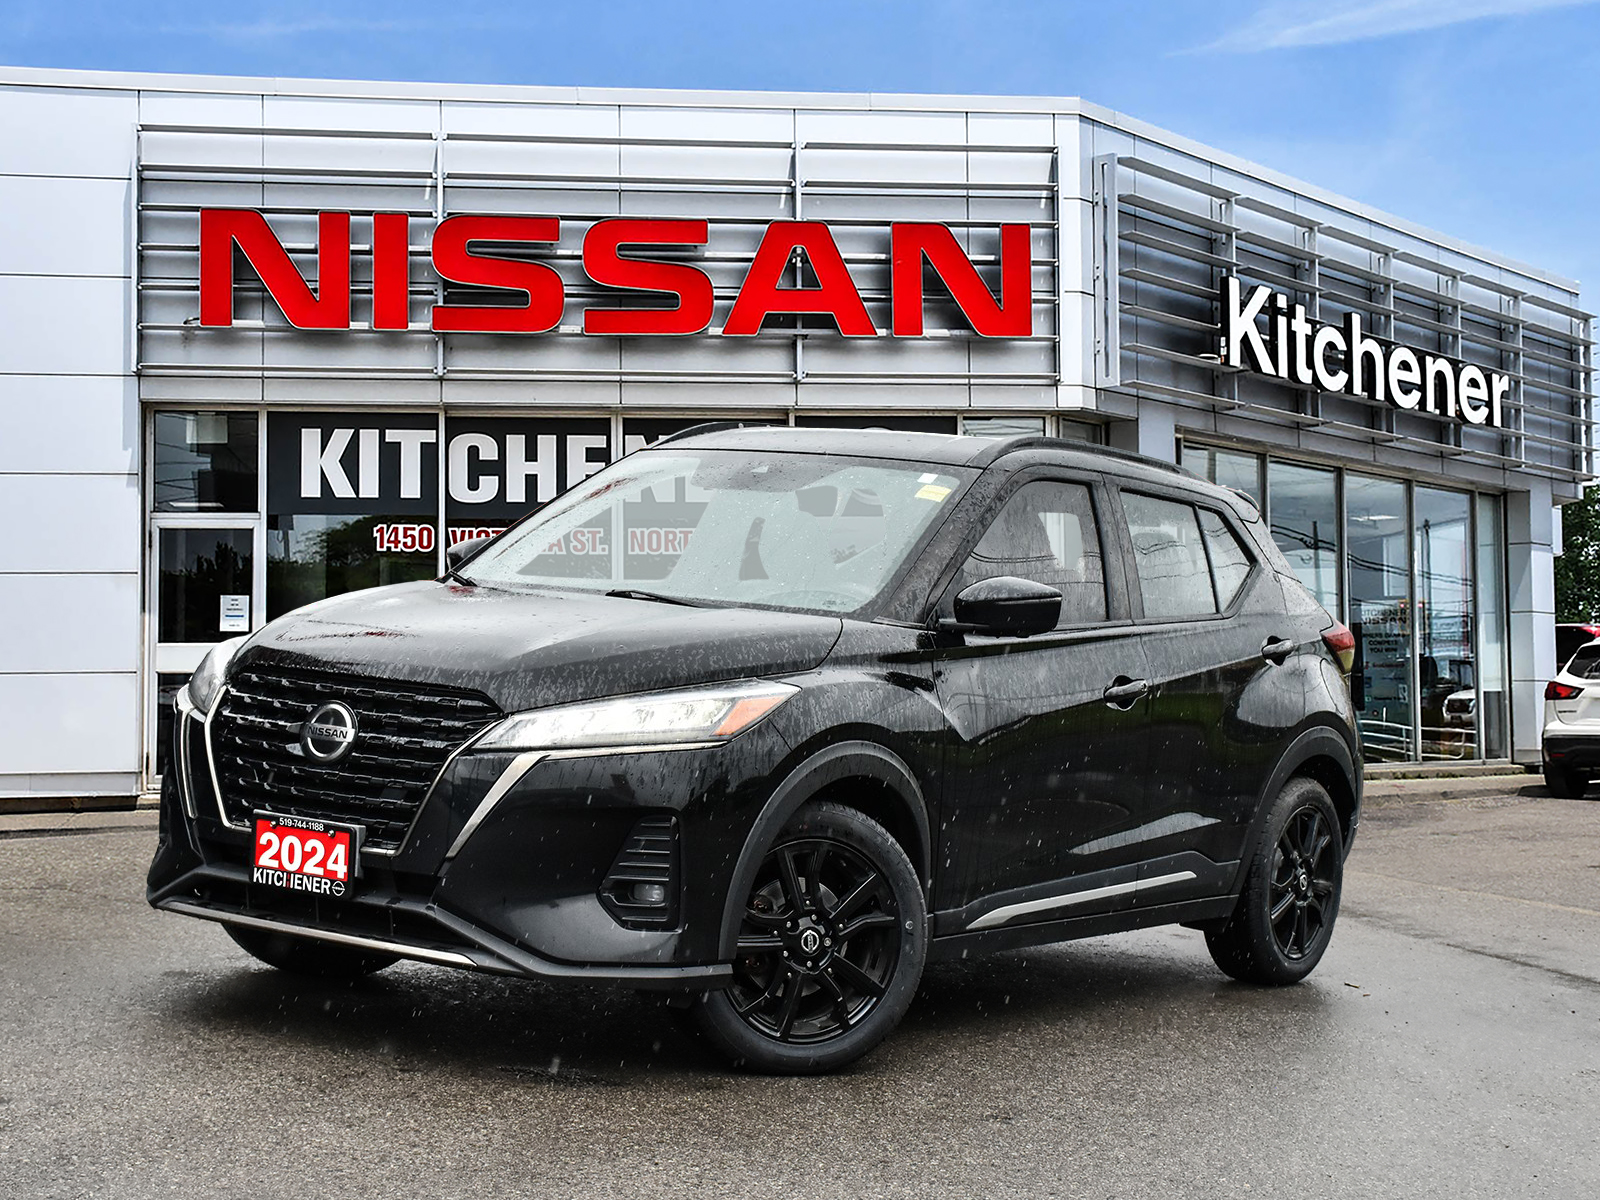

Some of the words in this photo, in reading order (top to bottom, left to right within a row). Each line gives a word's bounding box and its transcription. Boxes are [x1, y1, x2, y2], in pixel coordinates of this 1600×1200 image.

[199, 207, 1033, 338] NISSAN
[1226, 276, 1510, 428] Kitchener
[300, 427, 717, 504] KITCHEN
[373, 524, 435, 552] 1450
[569, 527, 609, 555] ST.
[627, 527, 696, 555] NORT
[308, 726, 348, 739] NISSAN
[279, 817, 324, 832] 519-744-1188
[258, 831, 348, 880] 2024
[253, 867, 331, 895] KITCHENER
